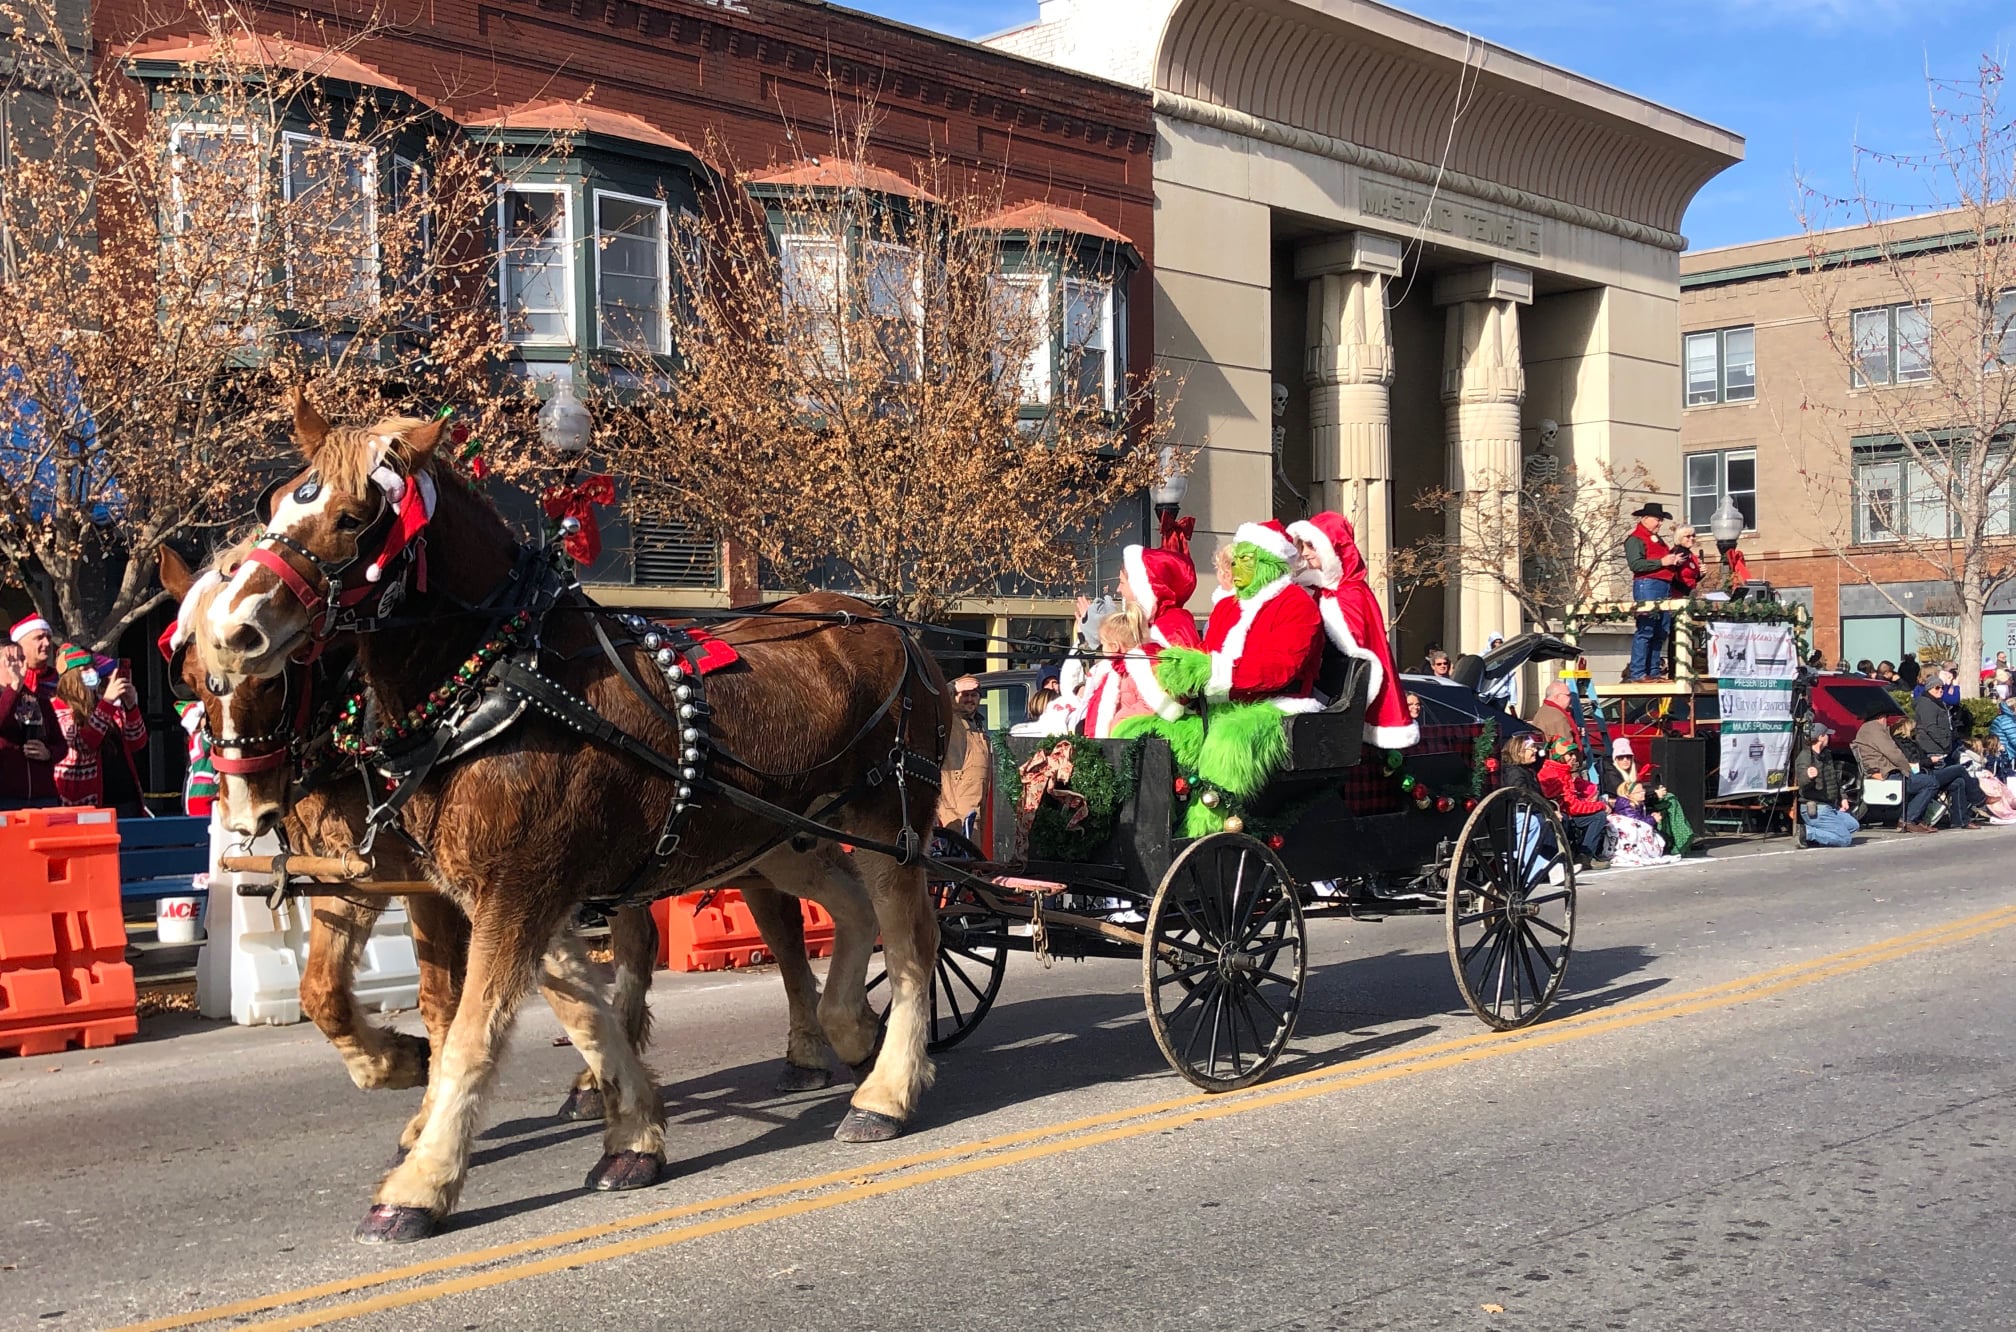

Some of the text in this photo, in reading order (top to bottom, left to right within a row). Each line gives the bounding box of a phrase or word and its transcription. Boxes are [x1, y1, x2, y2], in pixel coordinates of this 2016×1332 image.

[1361, 197, 1540, 254] MASONIC TEMPLE
[1736, 697, 1749, 713] City
[1751, 696, 1759, 713] of
[161, 902, 201, 918] ACE
